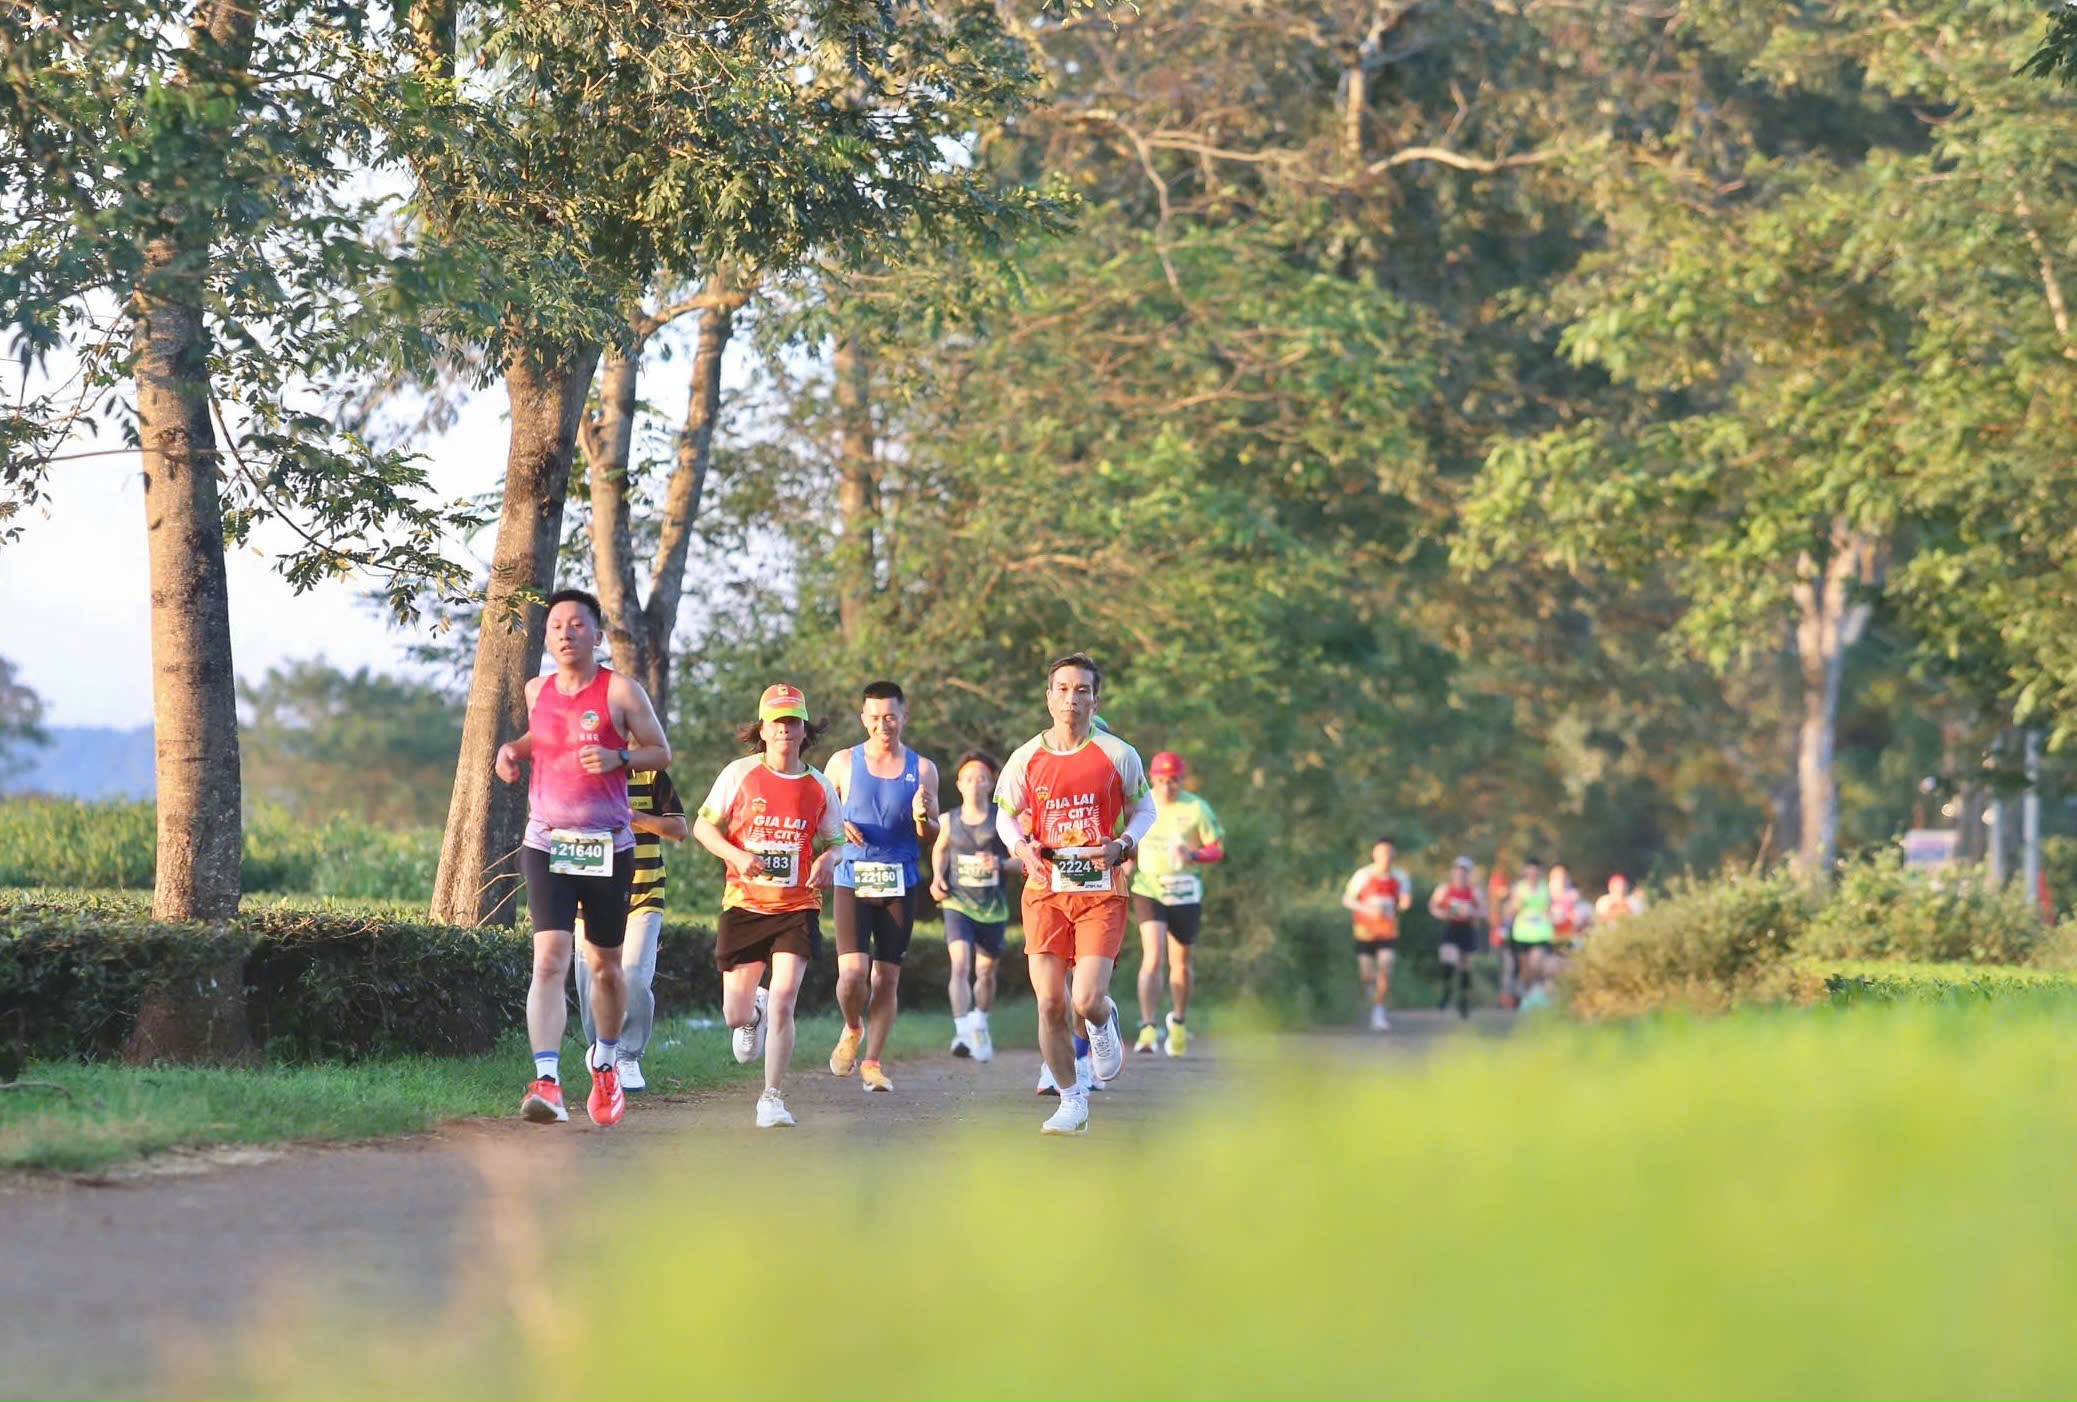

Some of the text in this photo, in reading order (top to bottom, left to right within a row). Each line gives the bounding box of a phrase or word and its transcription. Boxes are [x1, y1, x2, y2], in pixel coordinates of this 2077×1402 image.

[1046, 793, 1095, 810] GIA LAI
[1068, 806, 1093, 820] CITY
[753, 815, 807, 830] GIA LAI
[1057, 818, 1091, 832] TRAIL
[773, 829, 801, 841] CITY
[558, 843, 602, 858] 21640
[861, 870, 896, 883] 22160
